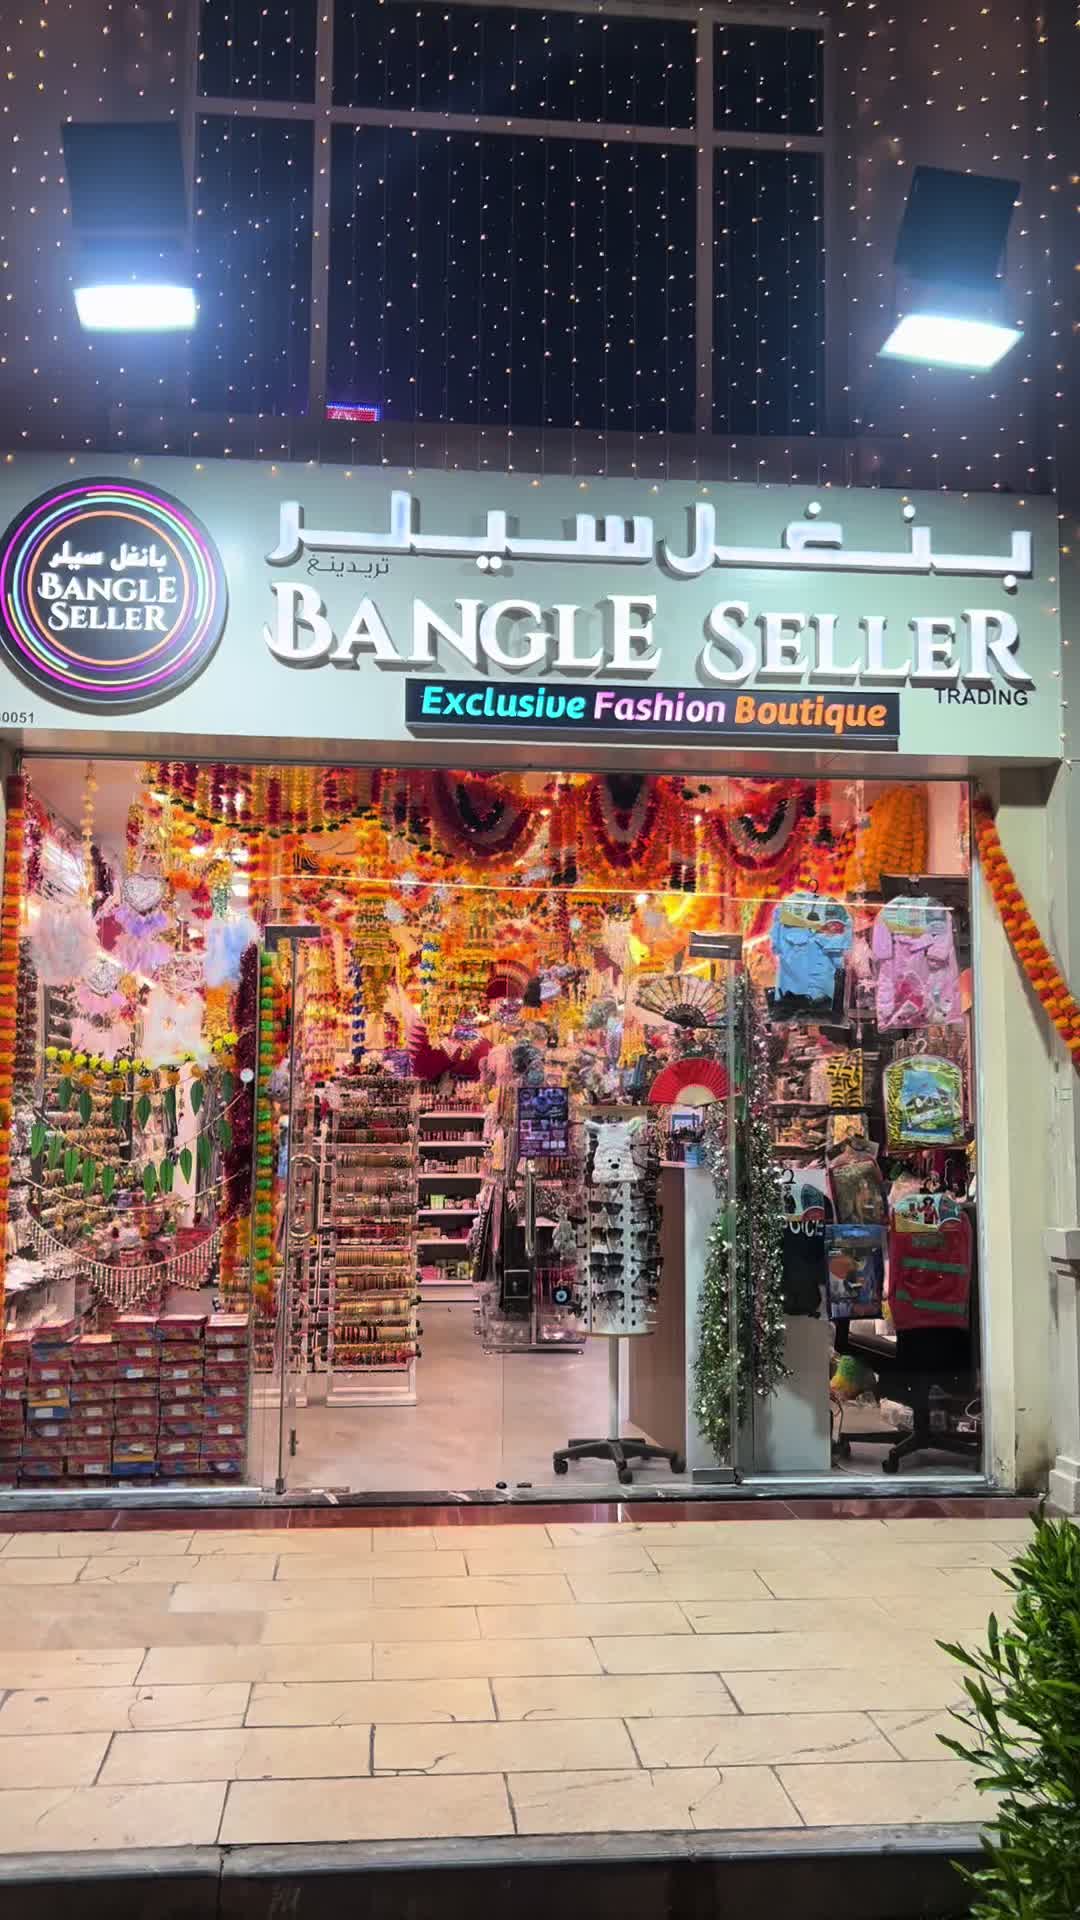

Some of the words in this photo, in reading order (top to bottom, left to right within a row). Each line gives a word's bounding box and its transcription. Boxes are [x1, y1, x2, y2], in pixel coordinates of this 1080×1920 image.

[48, 540, 104, 570] سيلر
[307, 554, 389, 578] تريدينغ
[37, 572, 177, 603] BANGLE
[48, 601, 168, 631] SELLER
[263, 582, 663, 675] BANGLE
[699, 600, 1034, 686] SELLER
[421, 686, 586, 719] Exclusive
[594, 691, 725, 723] Fashion
[735, 695, 887, 735] Boutique
[934, 687, 1029, 706] TRADING
[0, 711, 34, 724] 0051
